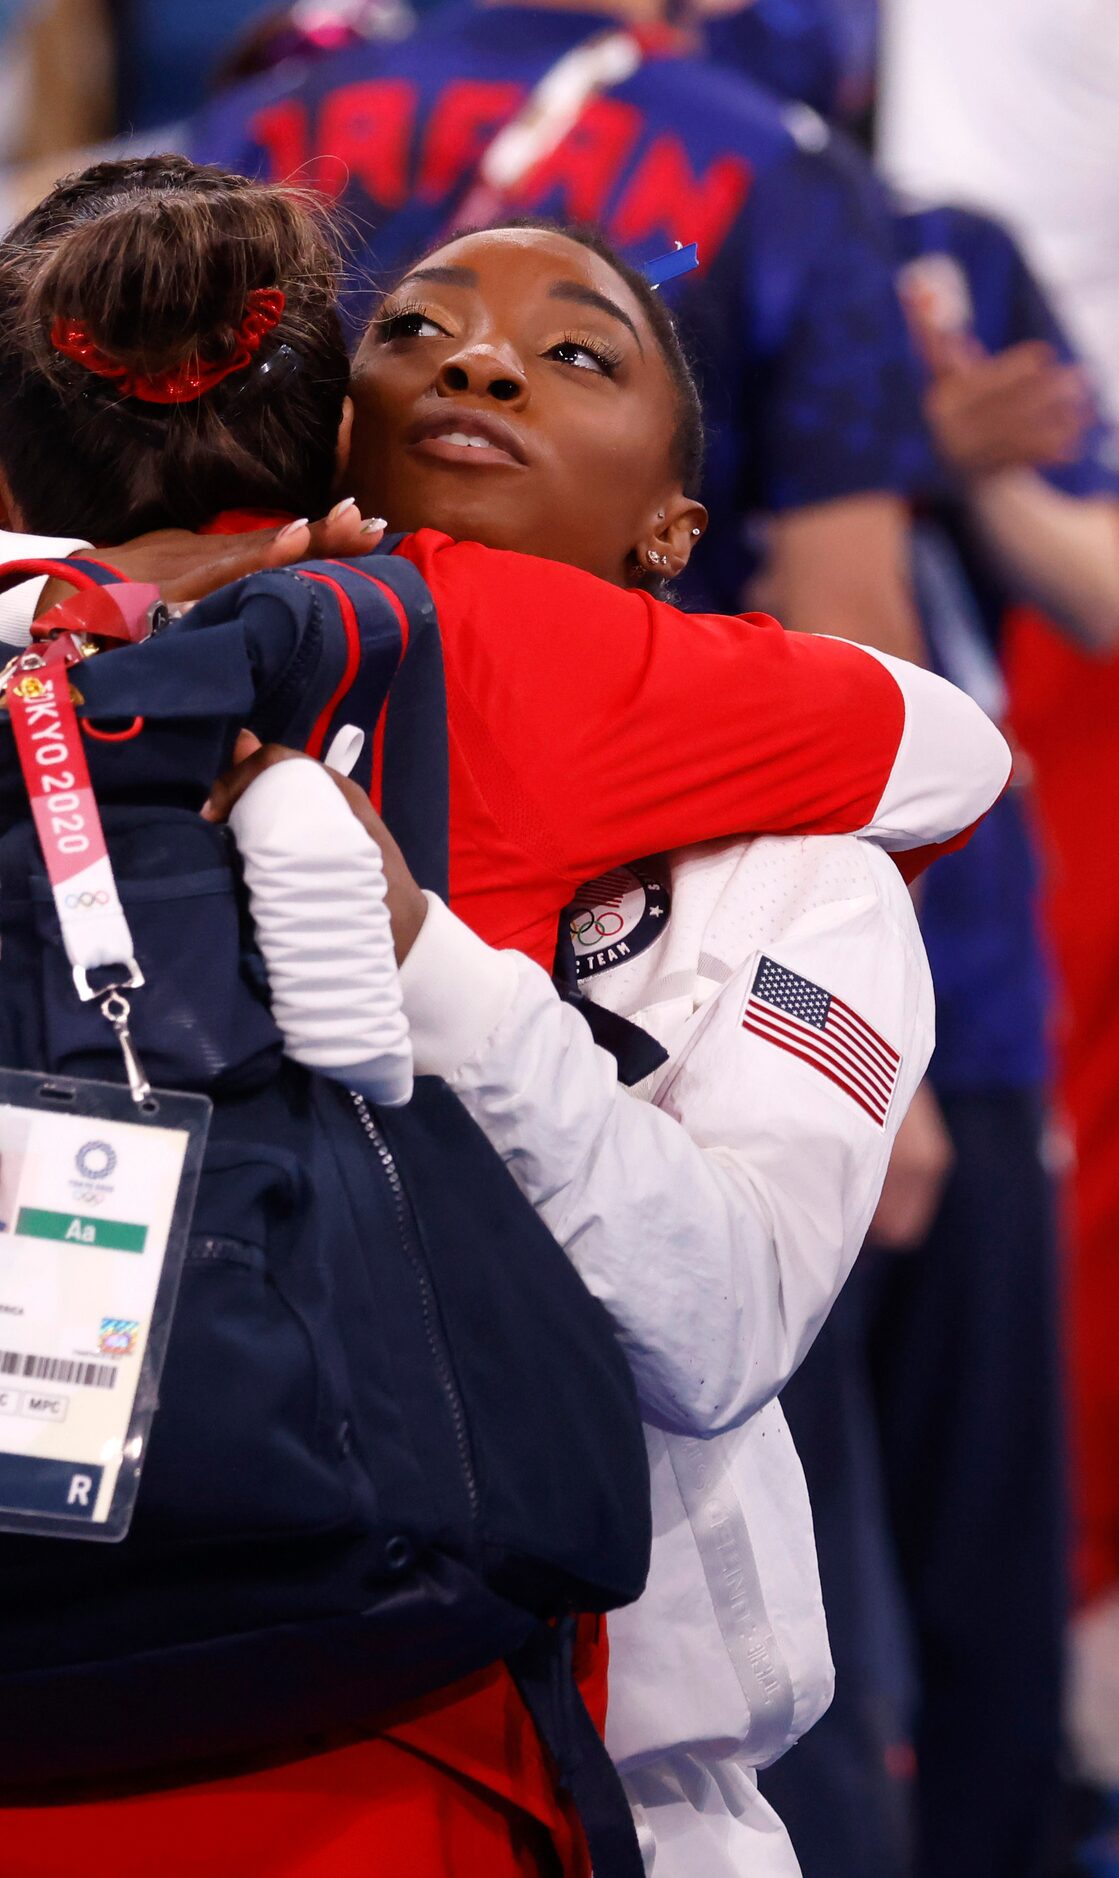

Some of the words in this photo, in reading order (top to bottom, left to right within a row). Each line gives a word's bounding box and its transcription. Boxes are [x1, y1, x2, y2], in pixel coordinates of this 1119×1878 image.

[250, 77, 753, 275] JAPAN
[41, 771, 90, 854] 2020
[586, 942, 631, 970] TEAM
[65, 1218, 97, 1243] Aa
[29, 1397, 60, 1414] MPC
[67, 1473, 92, 1506] R
